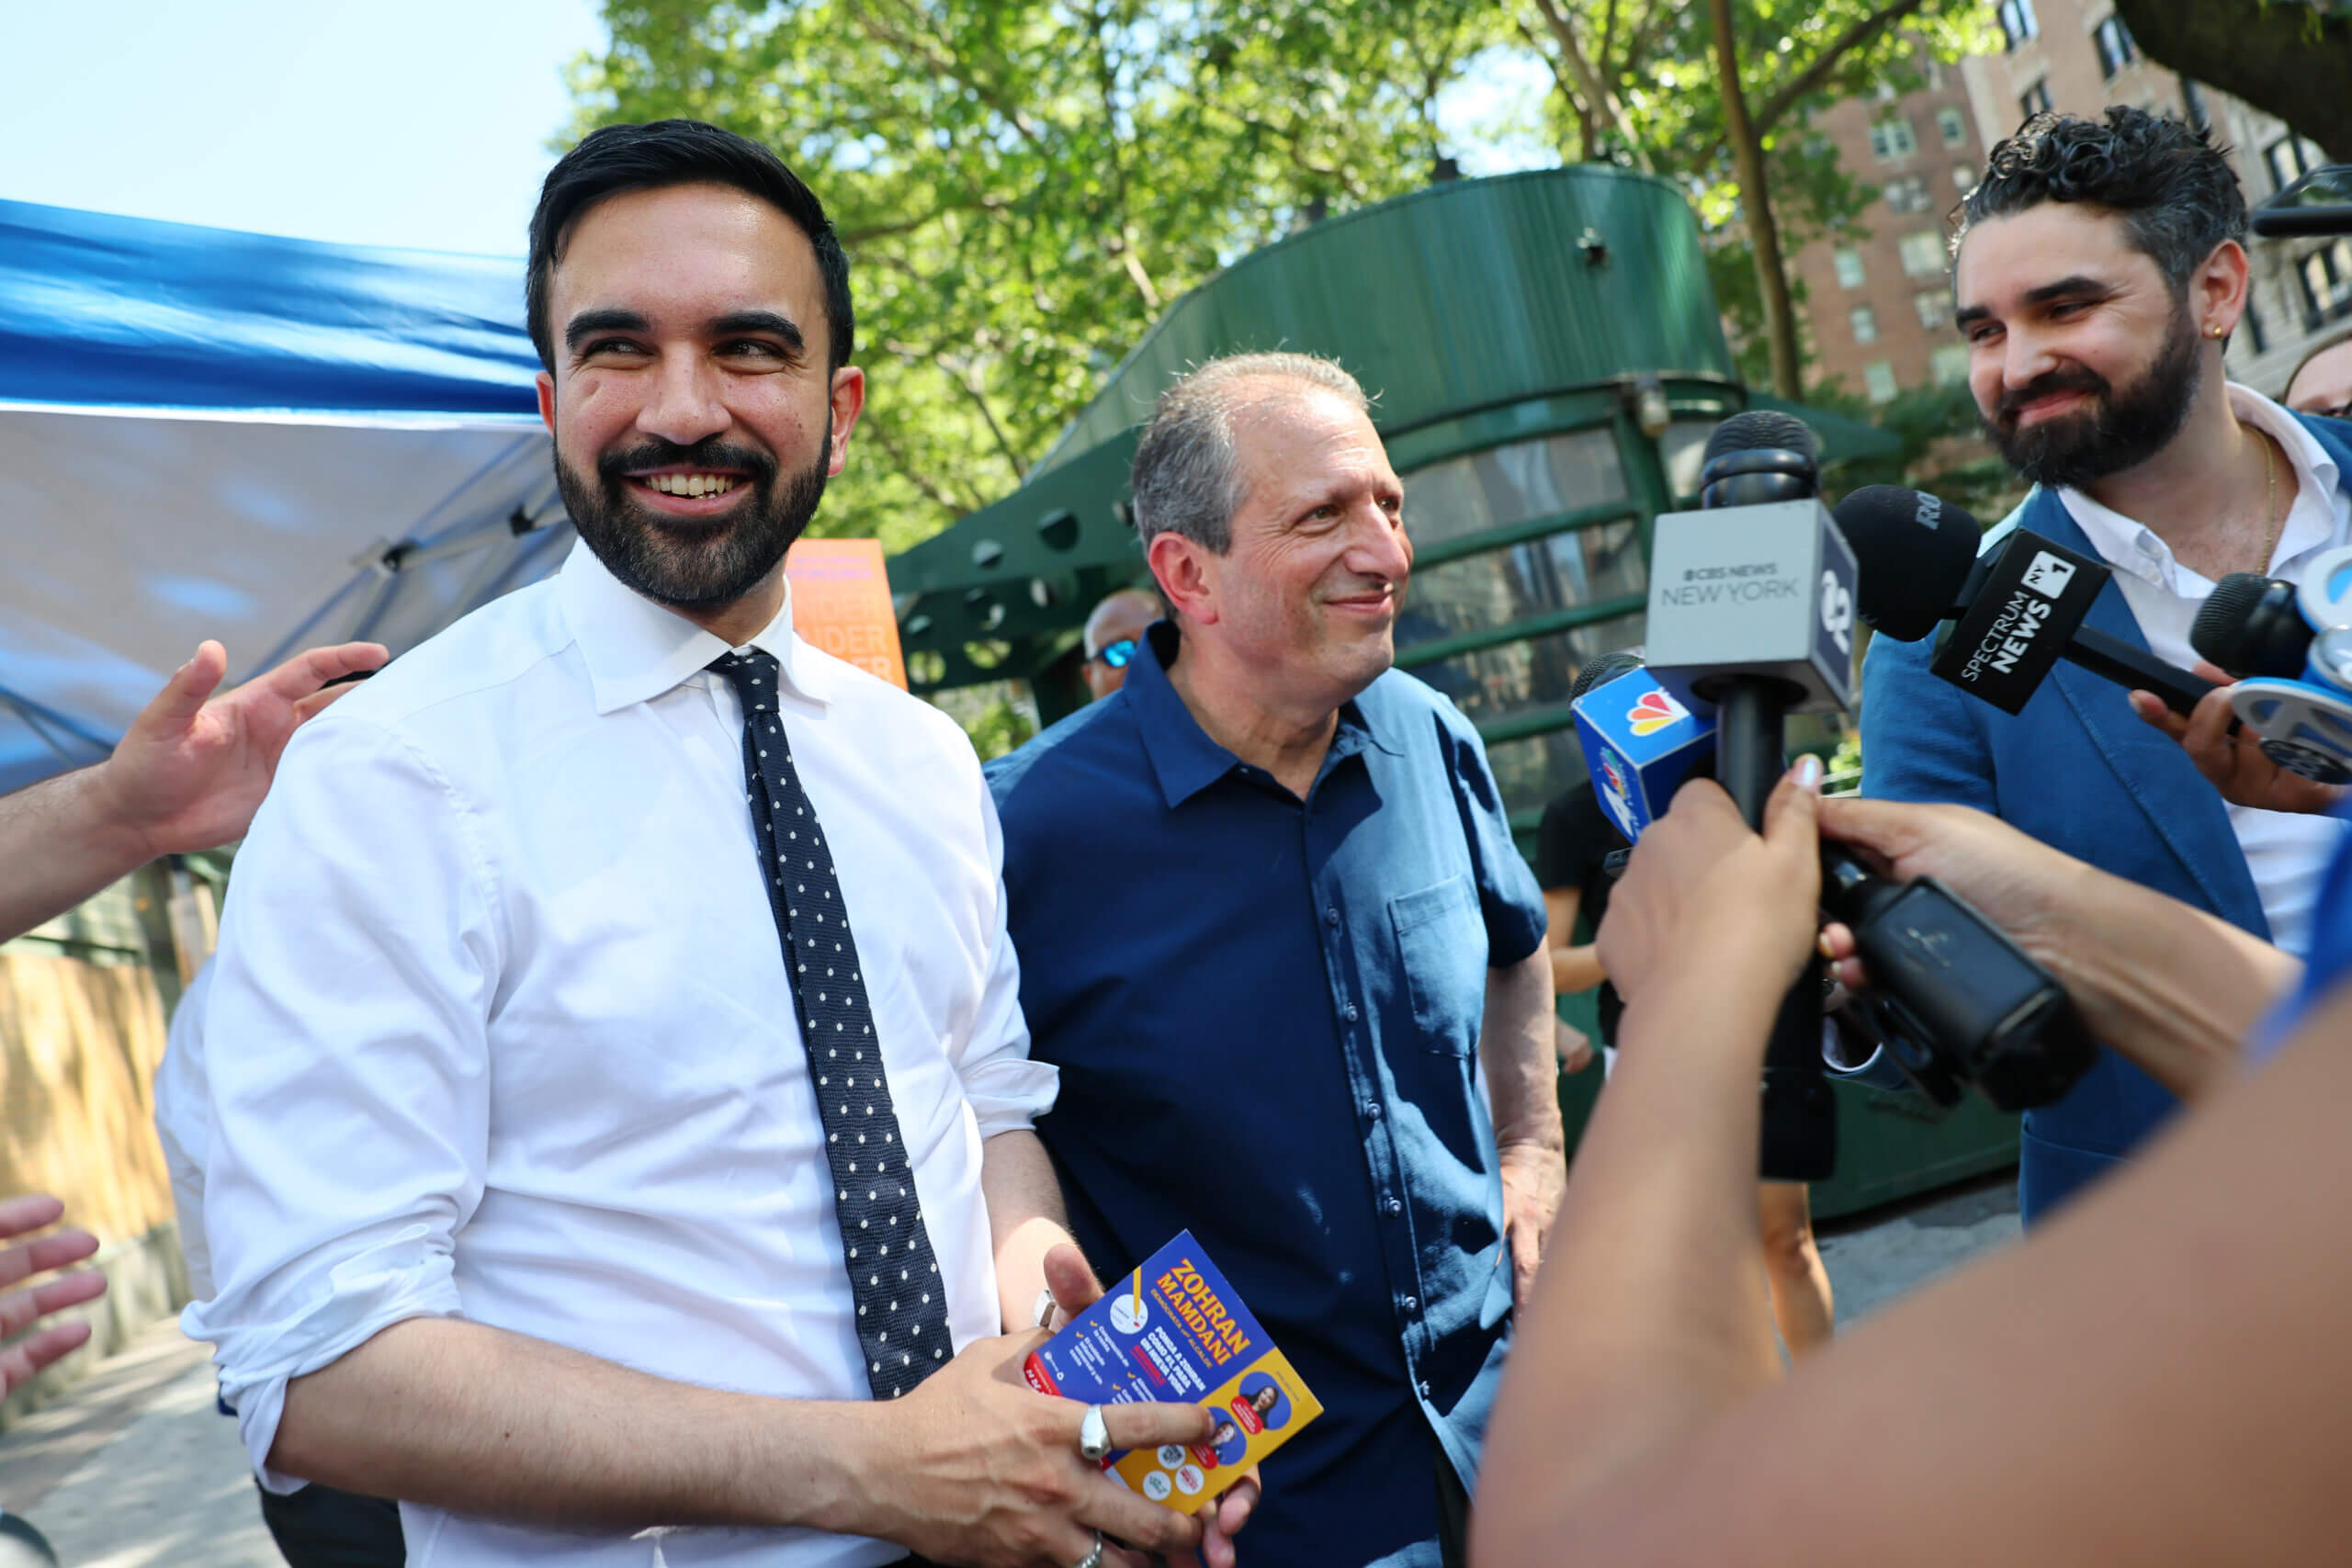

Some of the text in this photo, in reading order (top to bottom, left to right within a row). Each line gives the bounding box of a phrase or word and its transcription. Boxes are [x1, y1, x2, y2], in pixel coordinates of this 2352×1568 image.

[1661, 578, 1801, 606] NEW YORK
[1696, 562, 1778, 581] CBS NEWS
[2027, 564, 2045, 585] NY
[2051, 561, 2068, 578] 1
[1962, 591, 2030, 682] SPECTRUM
[1990, 598, 2053, 674] NEWS
[1155, 1271, 1232, 1366] MAMDANI
[1170, 1258, 1251, 1355] ZOHRAN
[1139, 1337, 1185, 1396] UN NUEVA YORK
[1147, 1331, 1168, 1356] COMO
[1170, 1364, 1191, 1388] PARA
[1154, 1325, 1206, 1392] PONGA A ZOHRAN
